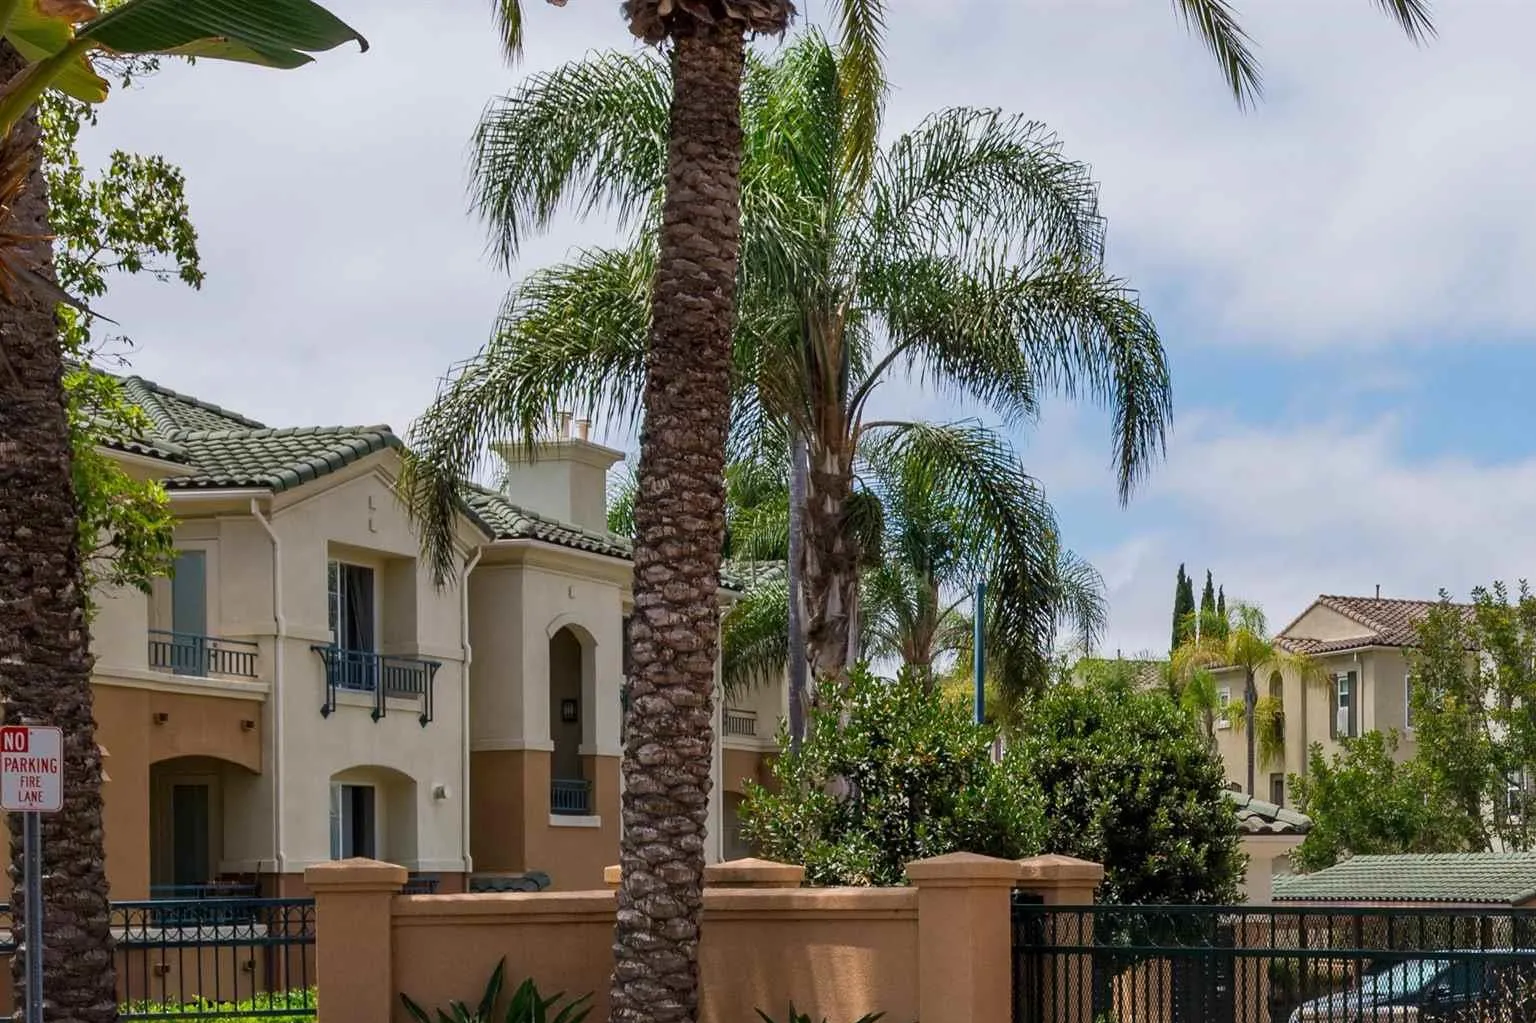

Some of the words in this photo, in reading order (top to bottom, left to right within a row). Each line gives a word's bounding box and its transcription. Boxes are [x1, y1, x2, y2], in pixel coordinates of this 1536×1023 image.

[4, 732, 25, 751] NO
[4, 757, 57, 773] PARKING
[20, 776, 41, 788] FIRE
[18, 791, 43, 803] LANE
